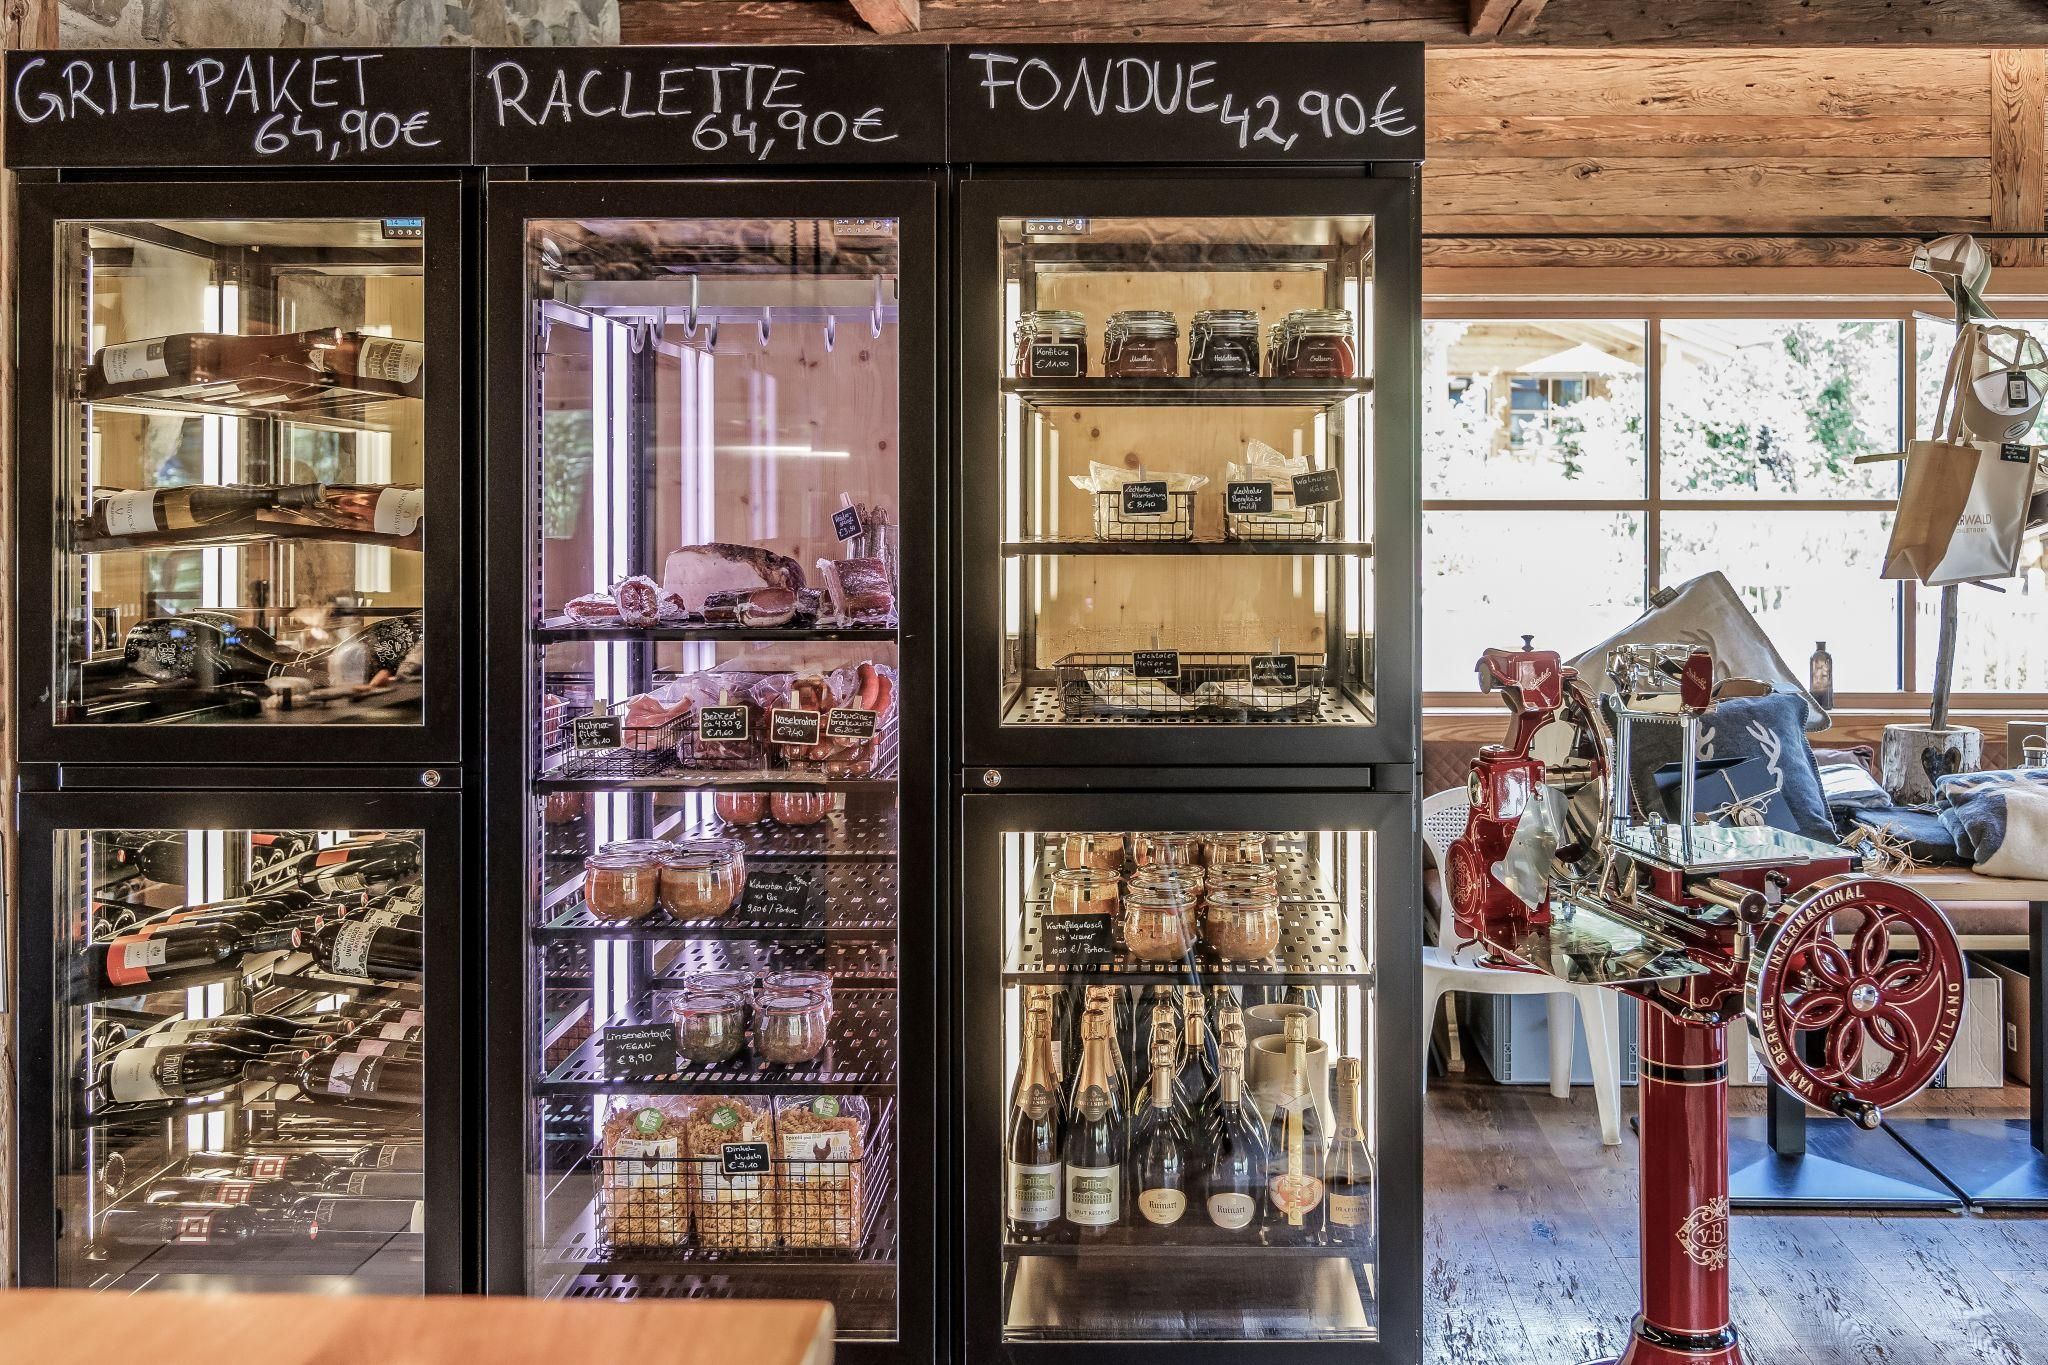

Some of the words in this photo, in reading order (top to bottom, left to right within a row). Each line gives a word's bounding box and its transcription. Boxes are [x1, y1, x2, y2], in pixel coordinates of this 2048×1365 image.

[15, 55, 383, 123] GRILLPAKET
[487, 62, 805, 127] RACLETTE
[969, 53, 1219, 115] FONDUE
[254, 109, 441, 161] 64,90€
[692, 108, 898, 161] 64,90€
[1220, 86, 1417, 151] 42,90€
[1768, 885, 1865, 972] INTERNATIONAL
[606, 1028, 672, 1041] Linseneintopf
[1761, 996, 1788, 1066] BERKEL
[1933, 982, 1960, 1054] MILANO
[1788, 1068, 1814, 1097] VAN
[1149, 1200, 1177, 1210] Ruinart
[1217, 1204, 1246, 1215] Ruinart
